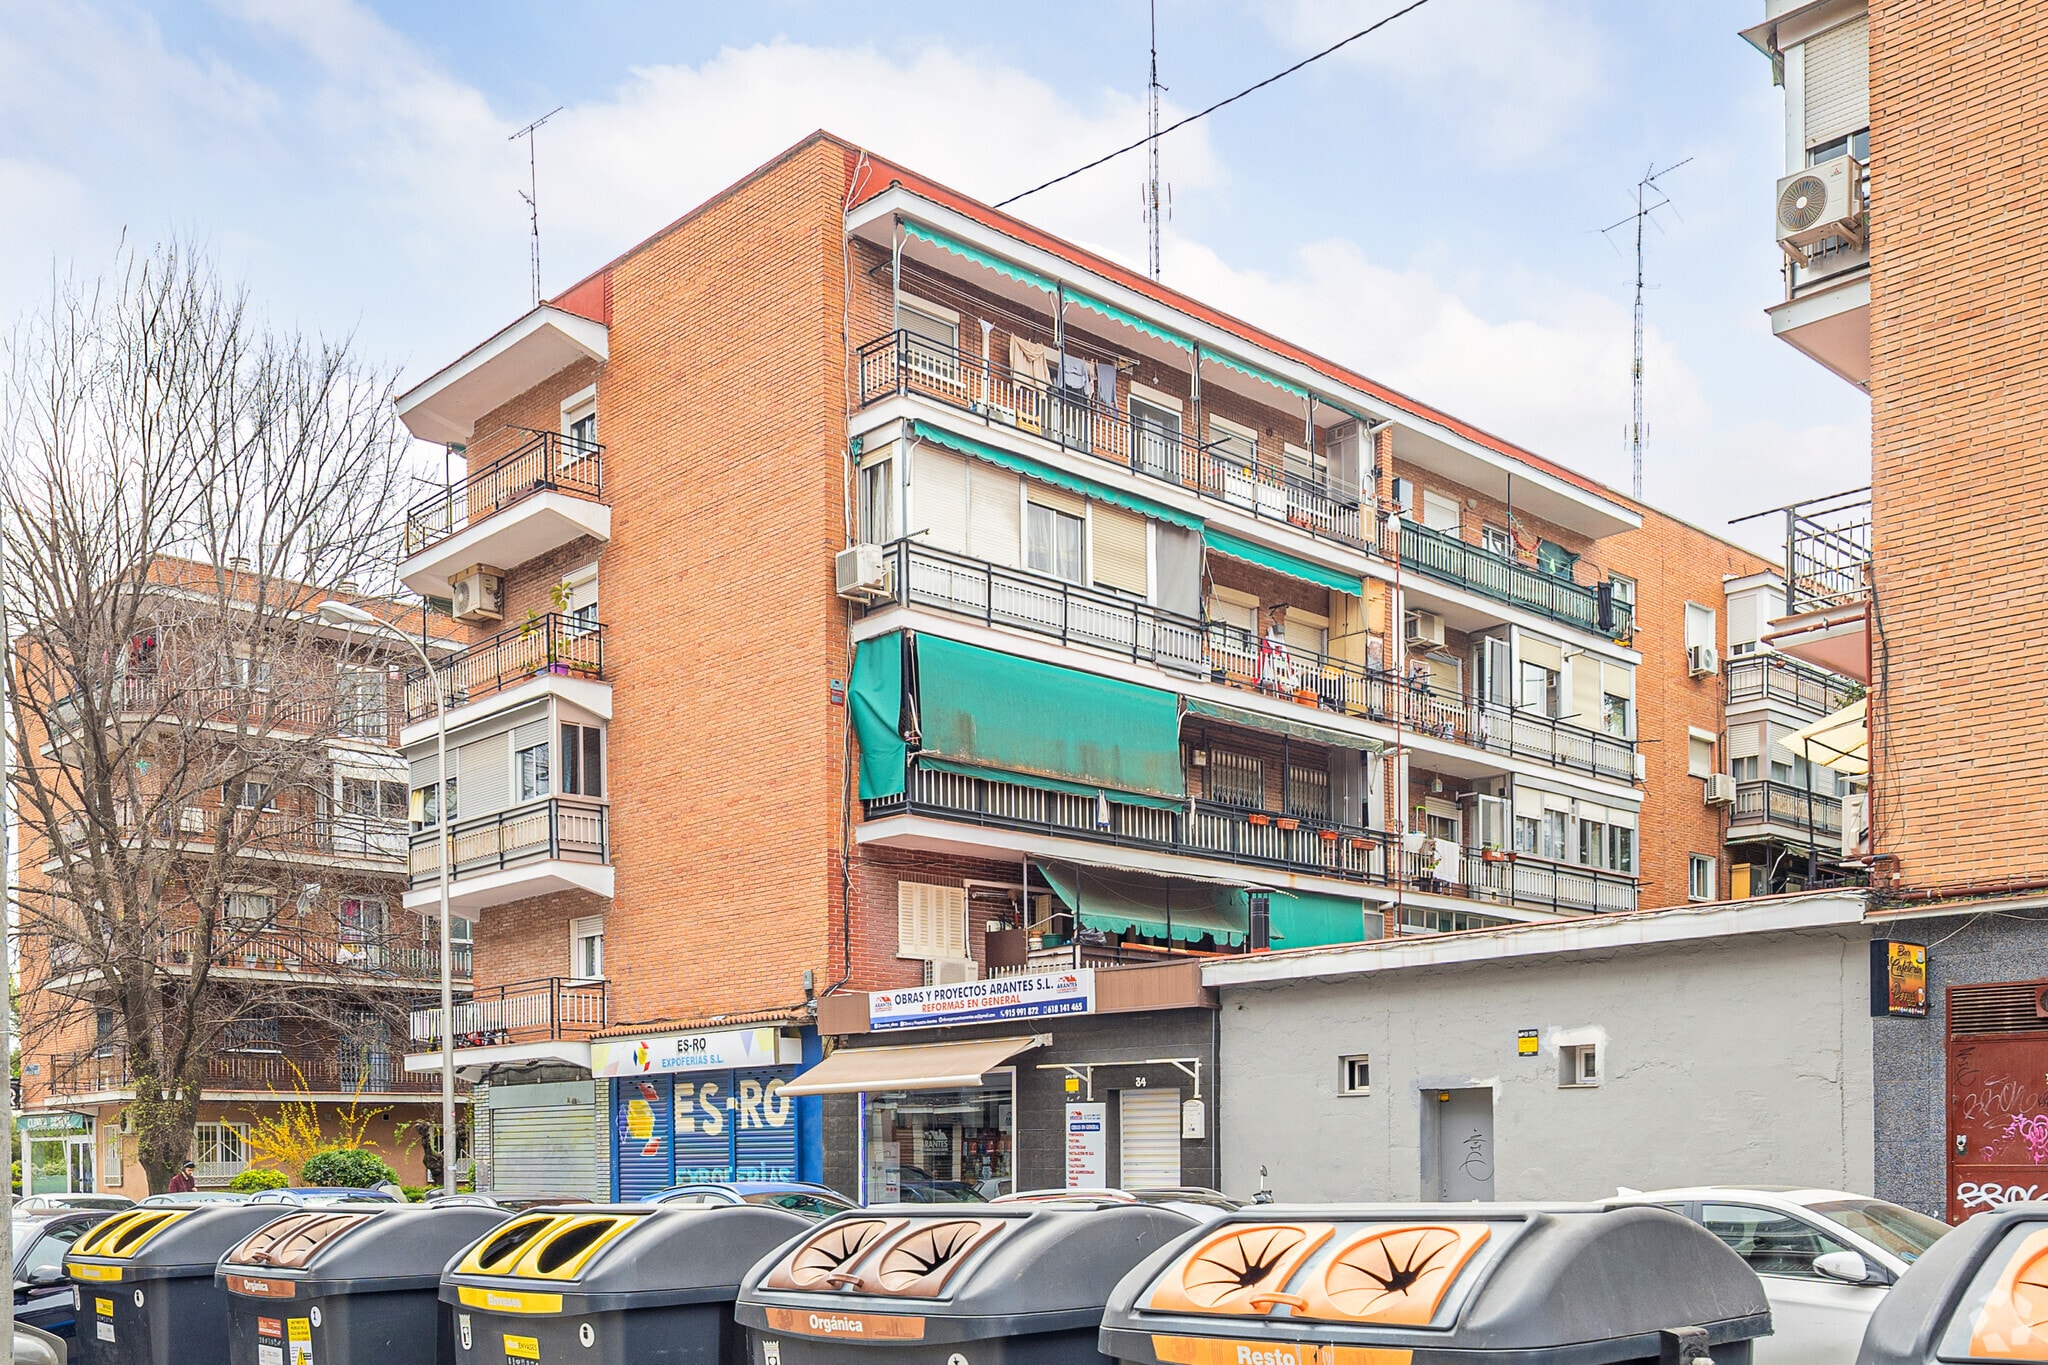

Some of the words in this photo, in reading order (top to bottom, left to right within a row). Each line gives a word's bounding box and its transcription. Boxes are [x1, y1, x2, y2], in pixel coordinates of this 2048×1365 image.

[895, 992, 924, 1005] OBRAS
[926, 991, 933, 1002] Y
[935, 985, 986, 1001] PROYECTOS
[990, 980, 1033, 995] ARANTES
[1037, 978, 1053, 990] S.L.
[922, 1001, 965, 1013] REFORMAS
[967, 1000, 979, 1008] EN
[982, 995, 1021, 1007] GENERAL
[1048, 1005, 1058, 1014] 618
[1060, 1003, 1070, 1012] 141
[1071, 1002, 1082, 1011] 465
[1004, 1008, 1015, 1017] 915
[1017, 1007, 1026, 1016] 991
[1028, 1006, 1039, 1015] 872
[677, 1037, 707, 1051] ES-RO
[662, 1055, 708, 1067] EXPOFERIAS
[710, 1054, 724, 1064] S.L.
[1135, 1076, 1146, 1087] 34
[674, 1078, 790, 1135] ES-RO
[922, 1139, 948, 1148] RANTES
[487, 1293, 522, 1308] Envases
[809, 1313, 863, 1333] Orgánica
[1236, 1345, 1295, 1365] Resto
